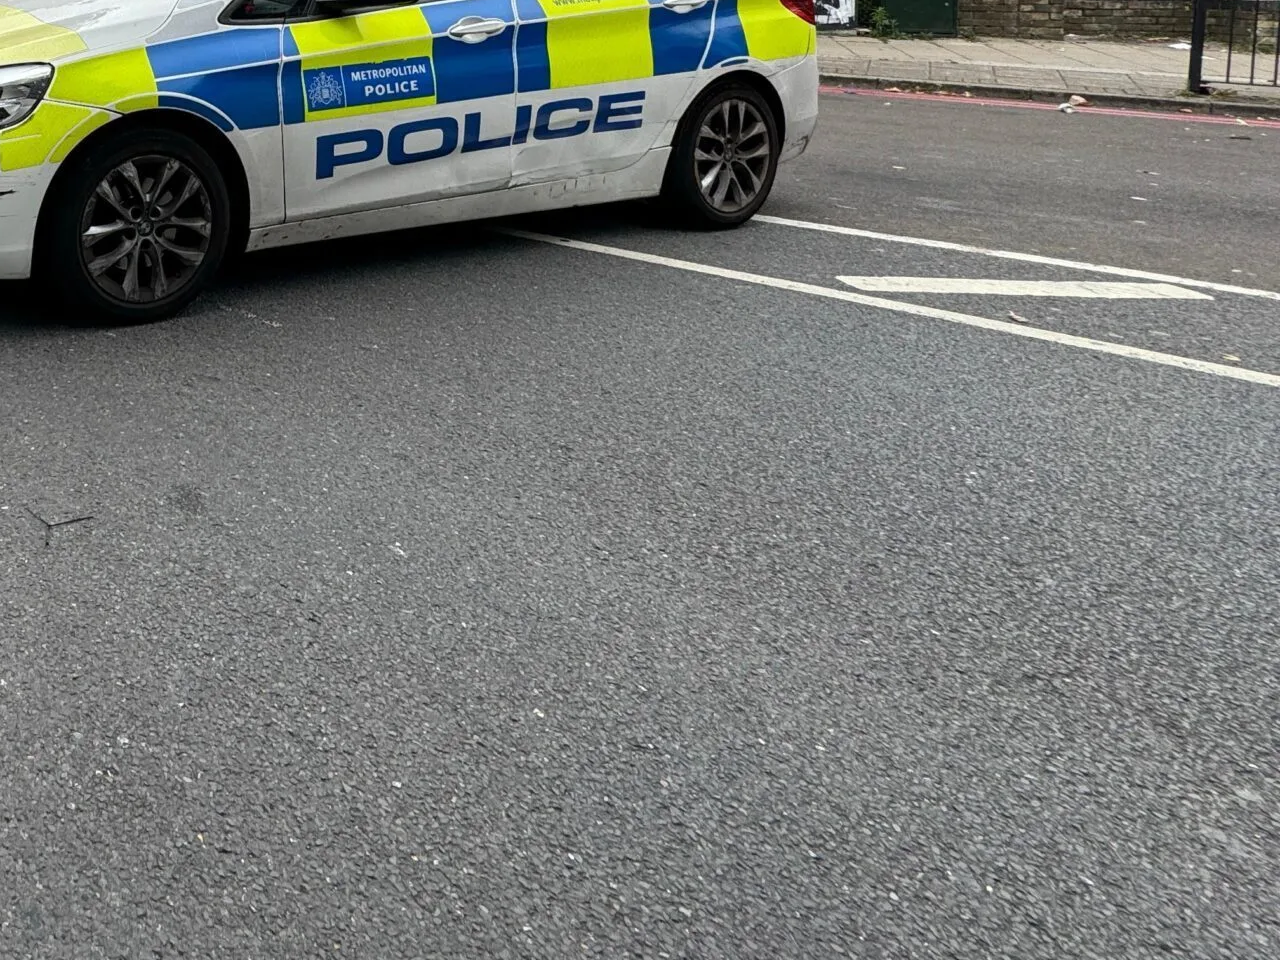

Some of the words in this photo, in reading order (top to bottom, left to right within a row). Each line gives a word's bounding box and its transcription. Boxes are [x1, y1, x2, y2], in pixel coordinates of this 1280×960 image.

[351, 64, 426, 82] METROPOLITAN
[364, 80, 419, 97] POLICE
[315, 90, 646, 180] POLICE
